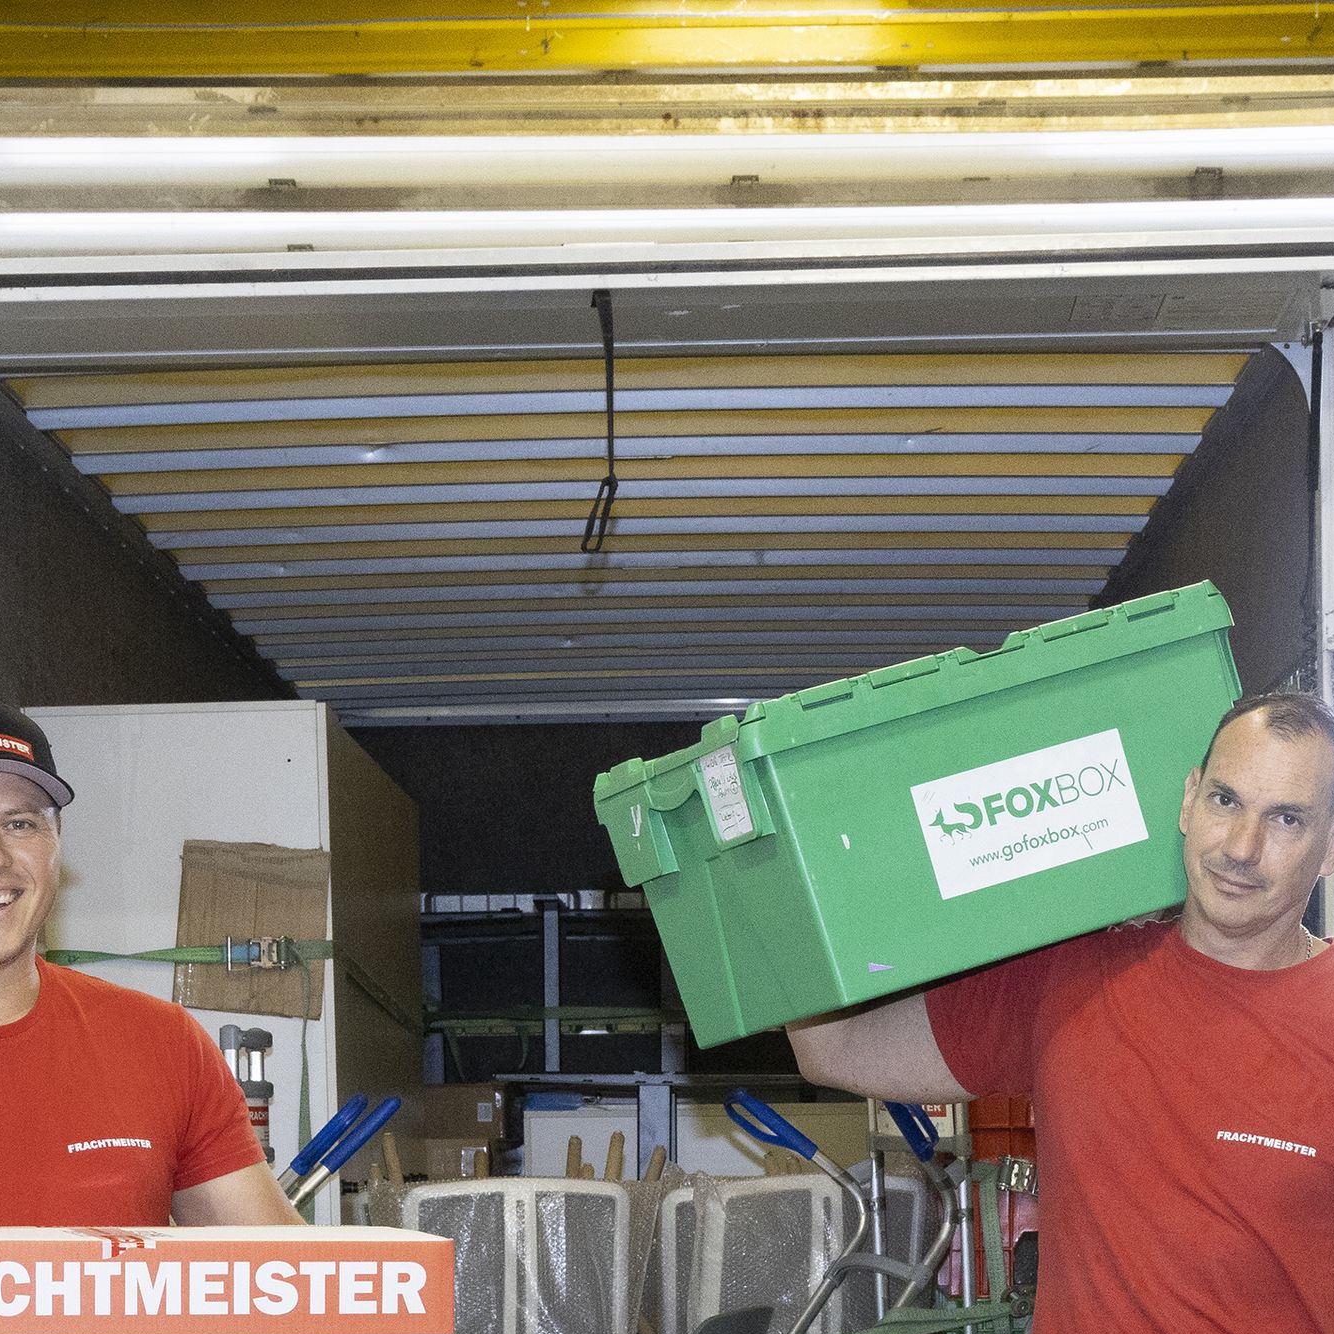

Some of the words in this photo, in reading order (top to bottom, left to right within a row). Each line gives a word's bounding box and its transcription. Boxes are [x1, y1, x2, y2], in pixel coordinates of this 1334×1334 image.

[982, 758, 1126, 827] FOXBOX
[969, 816, 1109, 867] www.gofoxbox.com
[67, 1138, 152, 1154] FRACHTMEISTER
[1216, 1130, 1317, 1157] FRACHTMEISTER
